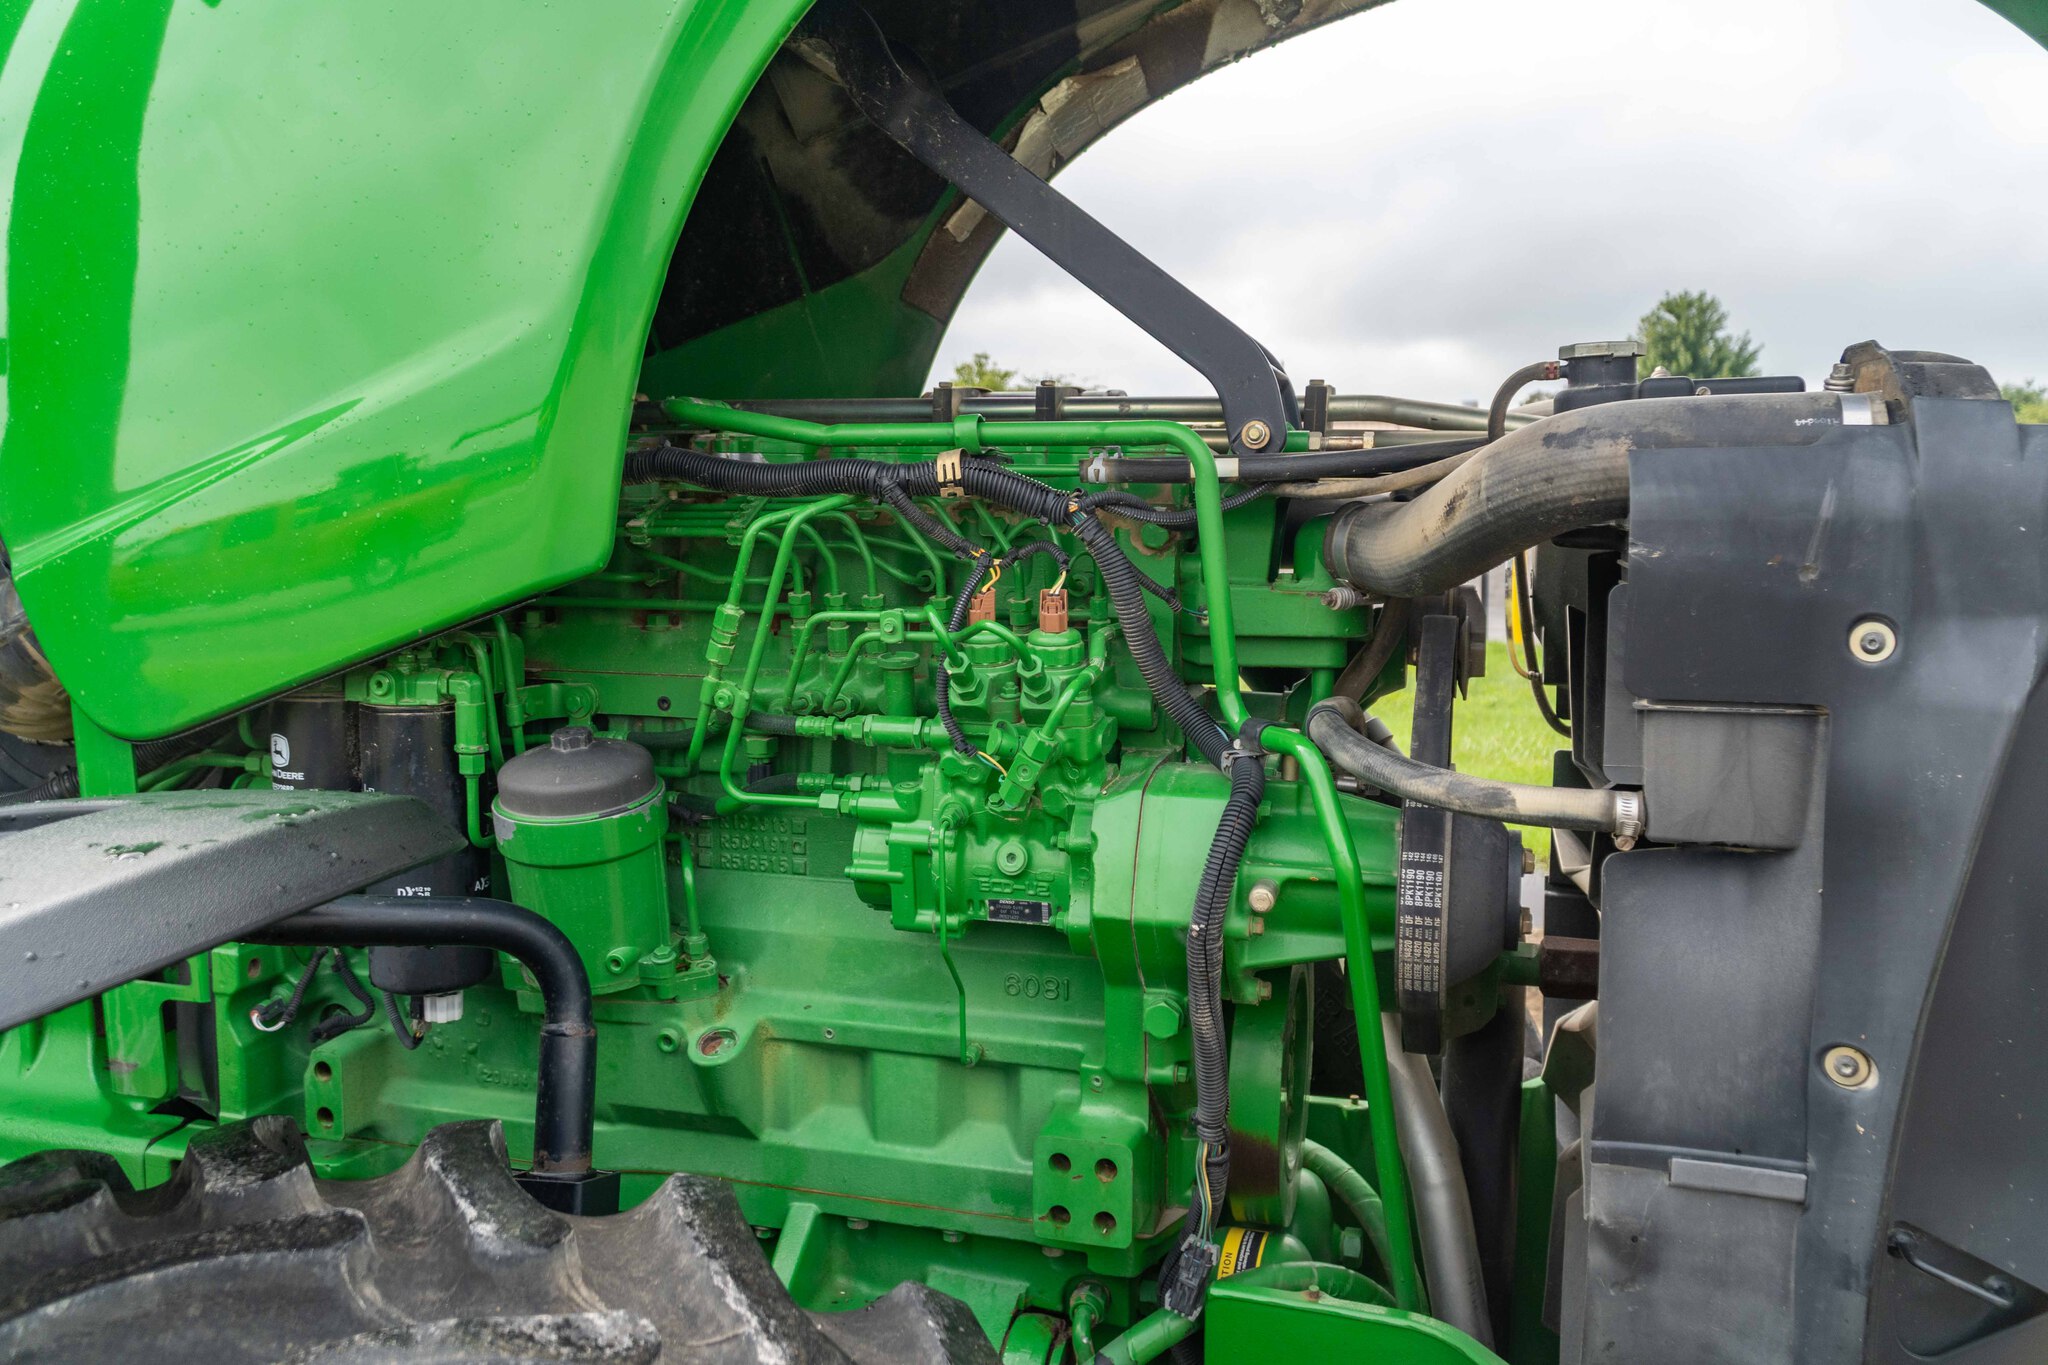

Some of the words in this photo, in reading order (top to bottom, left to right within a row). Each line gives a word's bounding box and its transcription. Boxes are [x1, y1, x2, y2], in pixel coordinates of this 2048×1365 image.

[277, 769, 305, 780] DEERE
[1405, 869, 1415, 906] 8PK1190
[1415, 869, 1425, 906] 8PK1190
[1424, 870, 1435, 908] 8PK1190
[1405, 915, 1414, 924] DF
[1414, 915, 1423, 925] DF
[1424, 916, 1433, 926] DF
[1004, 973, 1070, 1001] 6081
[1222, 1252, 1233, 1275] TION
